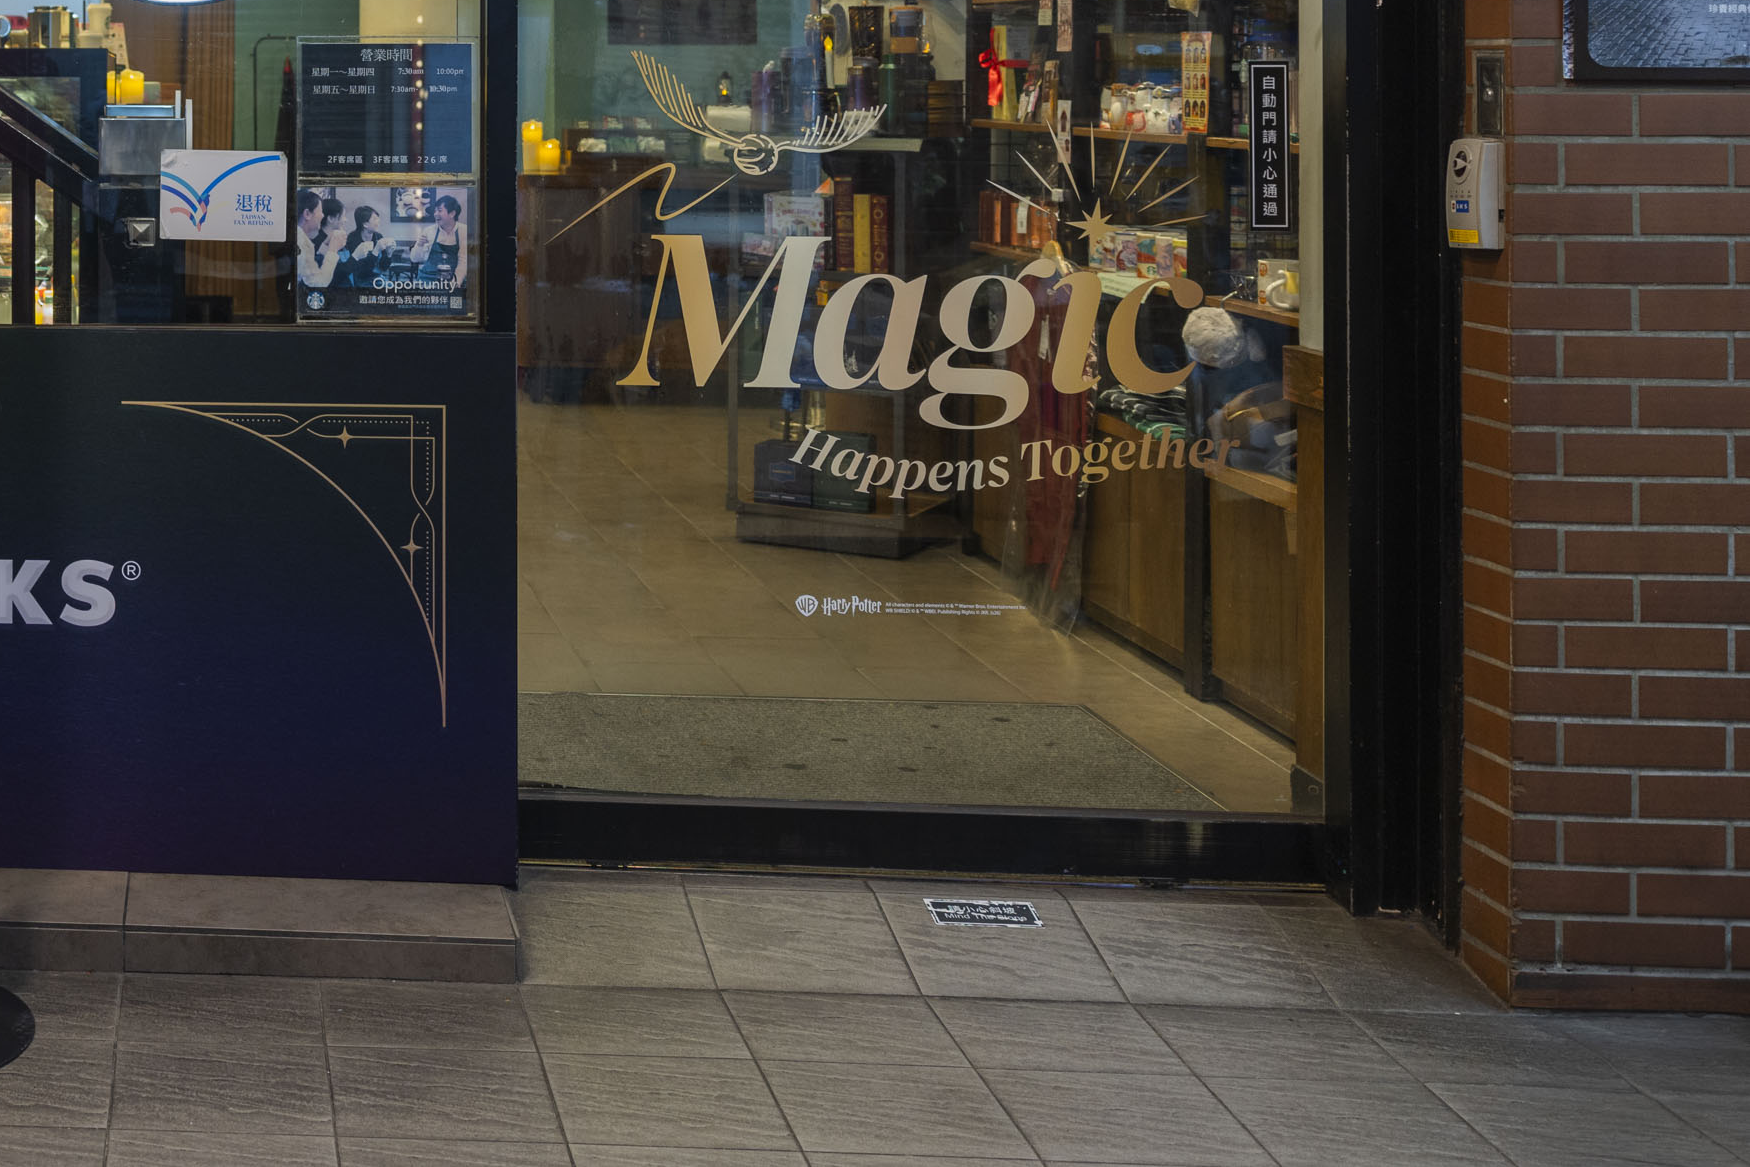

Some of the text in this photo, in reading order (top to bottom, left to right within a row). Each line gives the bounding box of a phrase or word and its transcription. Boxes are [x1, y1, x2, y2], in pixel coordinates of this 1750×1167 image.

[360, 48, 413, 62] 營業時間
[1262, 76, 1278, 217] 自動門請小心通過
[373, 277, 457, 293] Opportunity
[615, 234, 1204, 430] Magic
[788, 425, 1240, 500] Happens Together
[821, 595, 882, 617] Harry Potter
